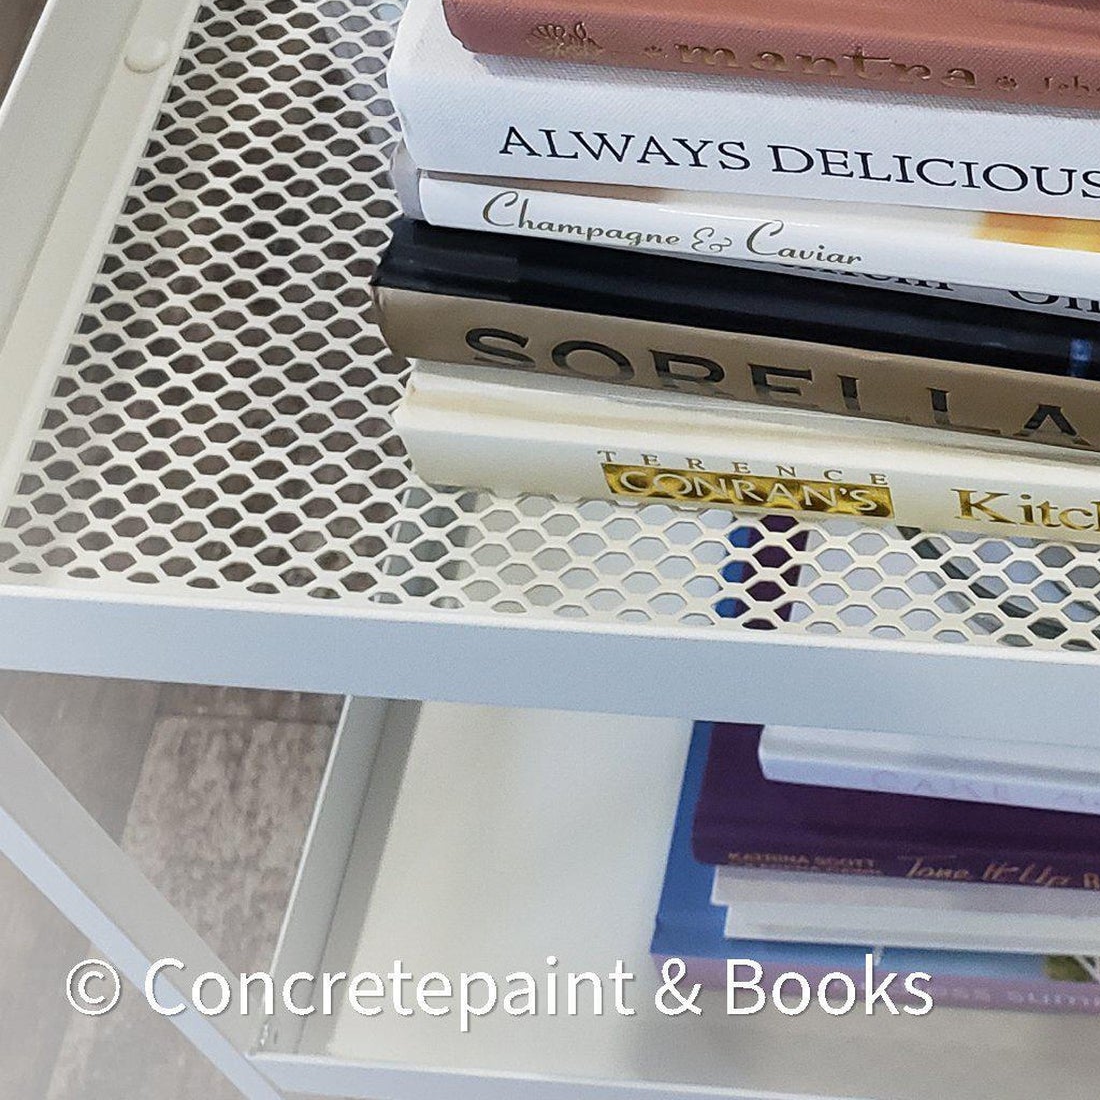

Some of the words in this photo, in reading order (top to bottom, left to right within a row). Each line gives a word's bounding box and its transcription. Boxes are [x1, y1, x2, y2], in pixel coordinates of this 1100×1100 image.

[674, 43, 980, 90] mantra
[499, 126, 751, 170] ALWAYS
[481, 190, 681, 247] Champagne
[691, 226, 733, 253] &
[745, 219, 863, 266] Caviar
[464, 327, 1091, 446] SORELLA
[597, 450, 889, 486] TERENCE
[619, 470, 878, 512] CONRAN'S
